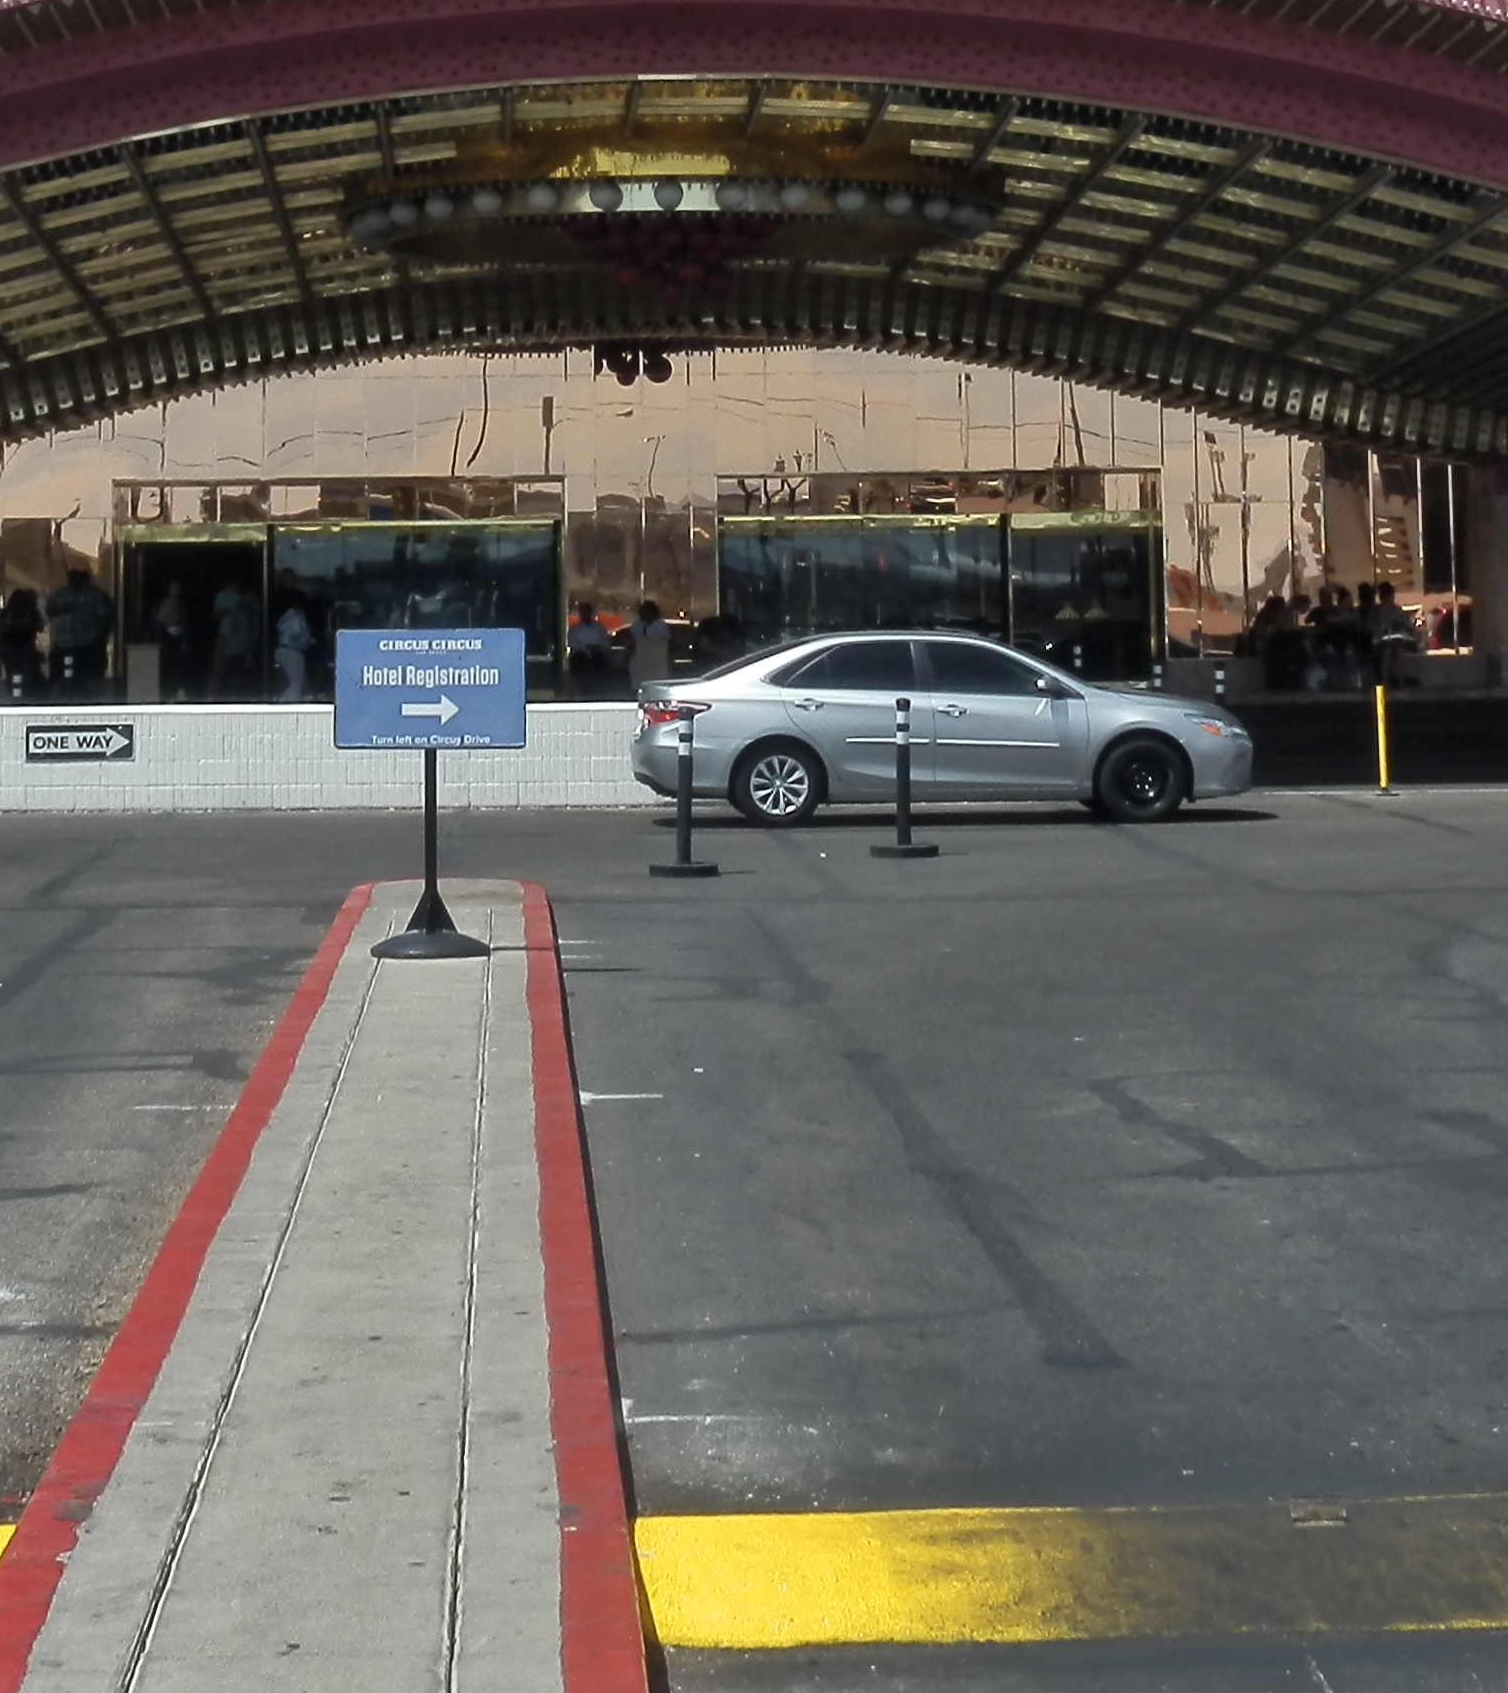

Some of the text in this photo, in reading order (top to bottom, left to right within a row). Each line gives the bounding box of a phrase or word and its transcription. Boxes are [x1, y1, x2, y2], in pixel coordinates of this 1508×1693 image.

[379, 638, 483, 651] CIRCUS CIRCUS
[363, 665, 500, 689] Hotel Registration
[32, 735, 113, 750] ONE WAY
[372, 733, 491, 746] Turn left on Circus Drive
